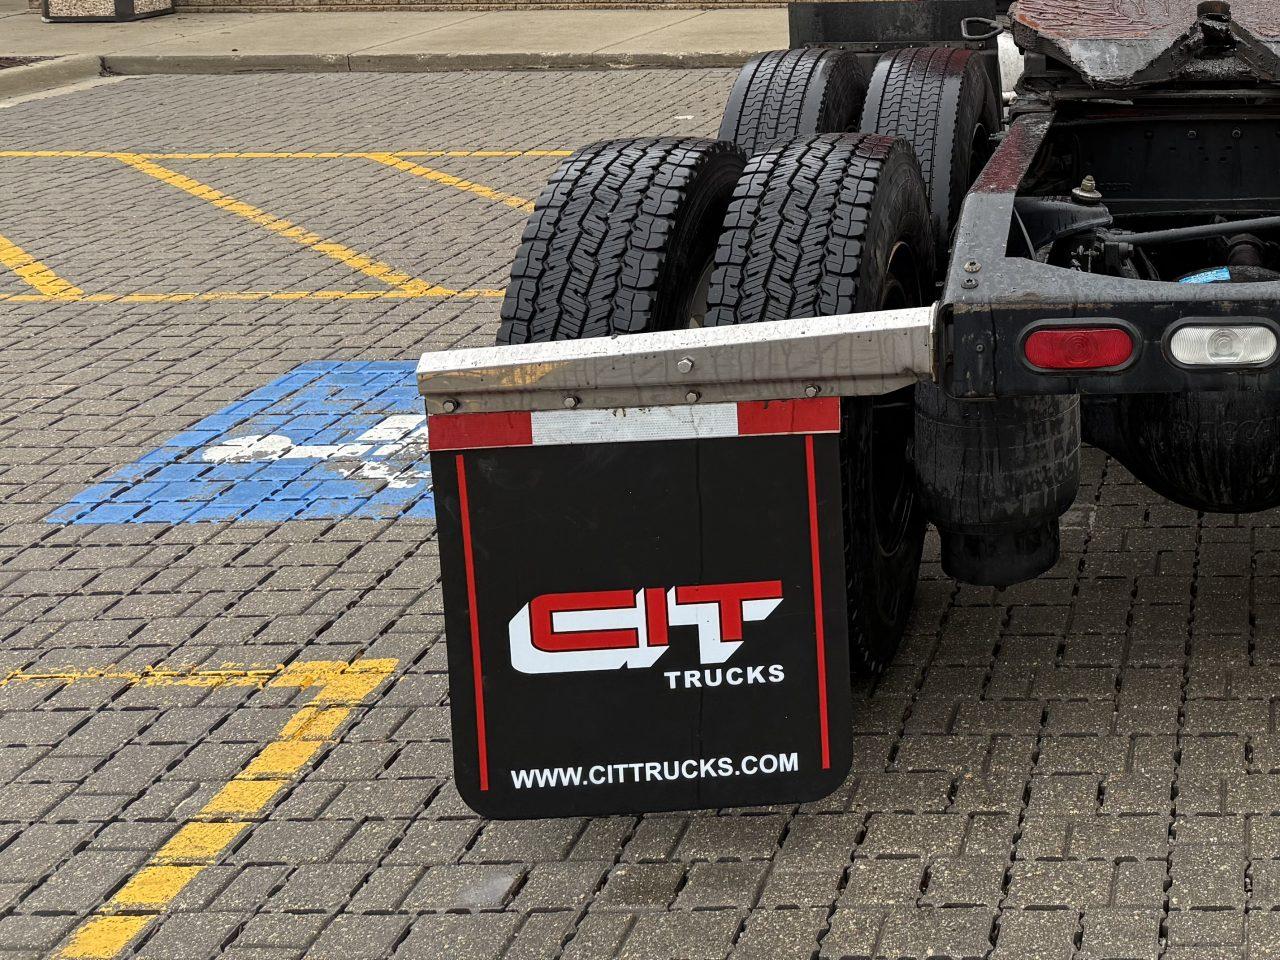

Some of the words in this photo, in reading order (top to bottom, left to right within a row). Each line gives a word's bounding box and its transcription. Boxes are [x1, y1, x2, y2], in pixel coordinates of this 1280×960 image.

[508, 580, 785, 674] CIT
[663, 664, 786, 690] TRUCKS
[510, 752, 799, 790] WWW.CITTRUCKS.COM
